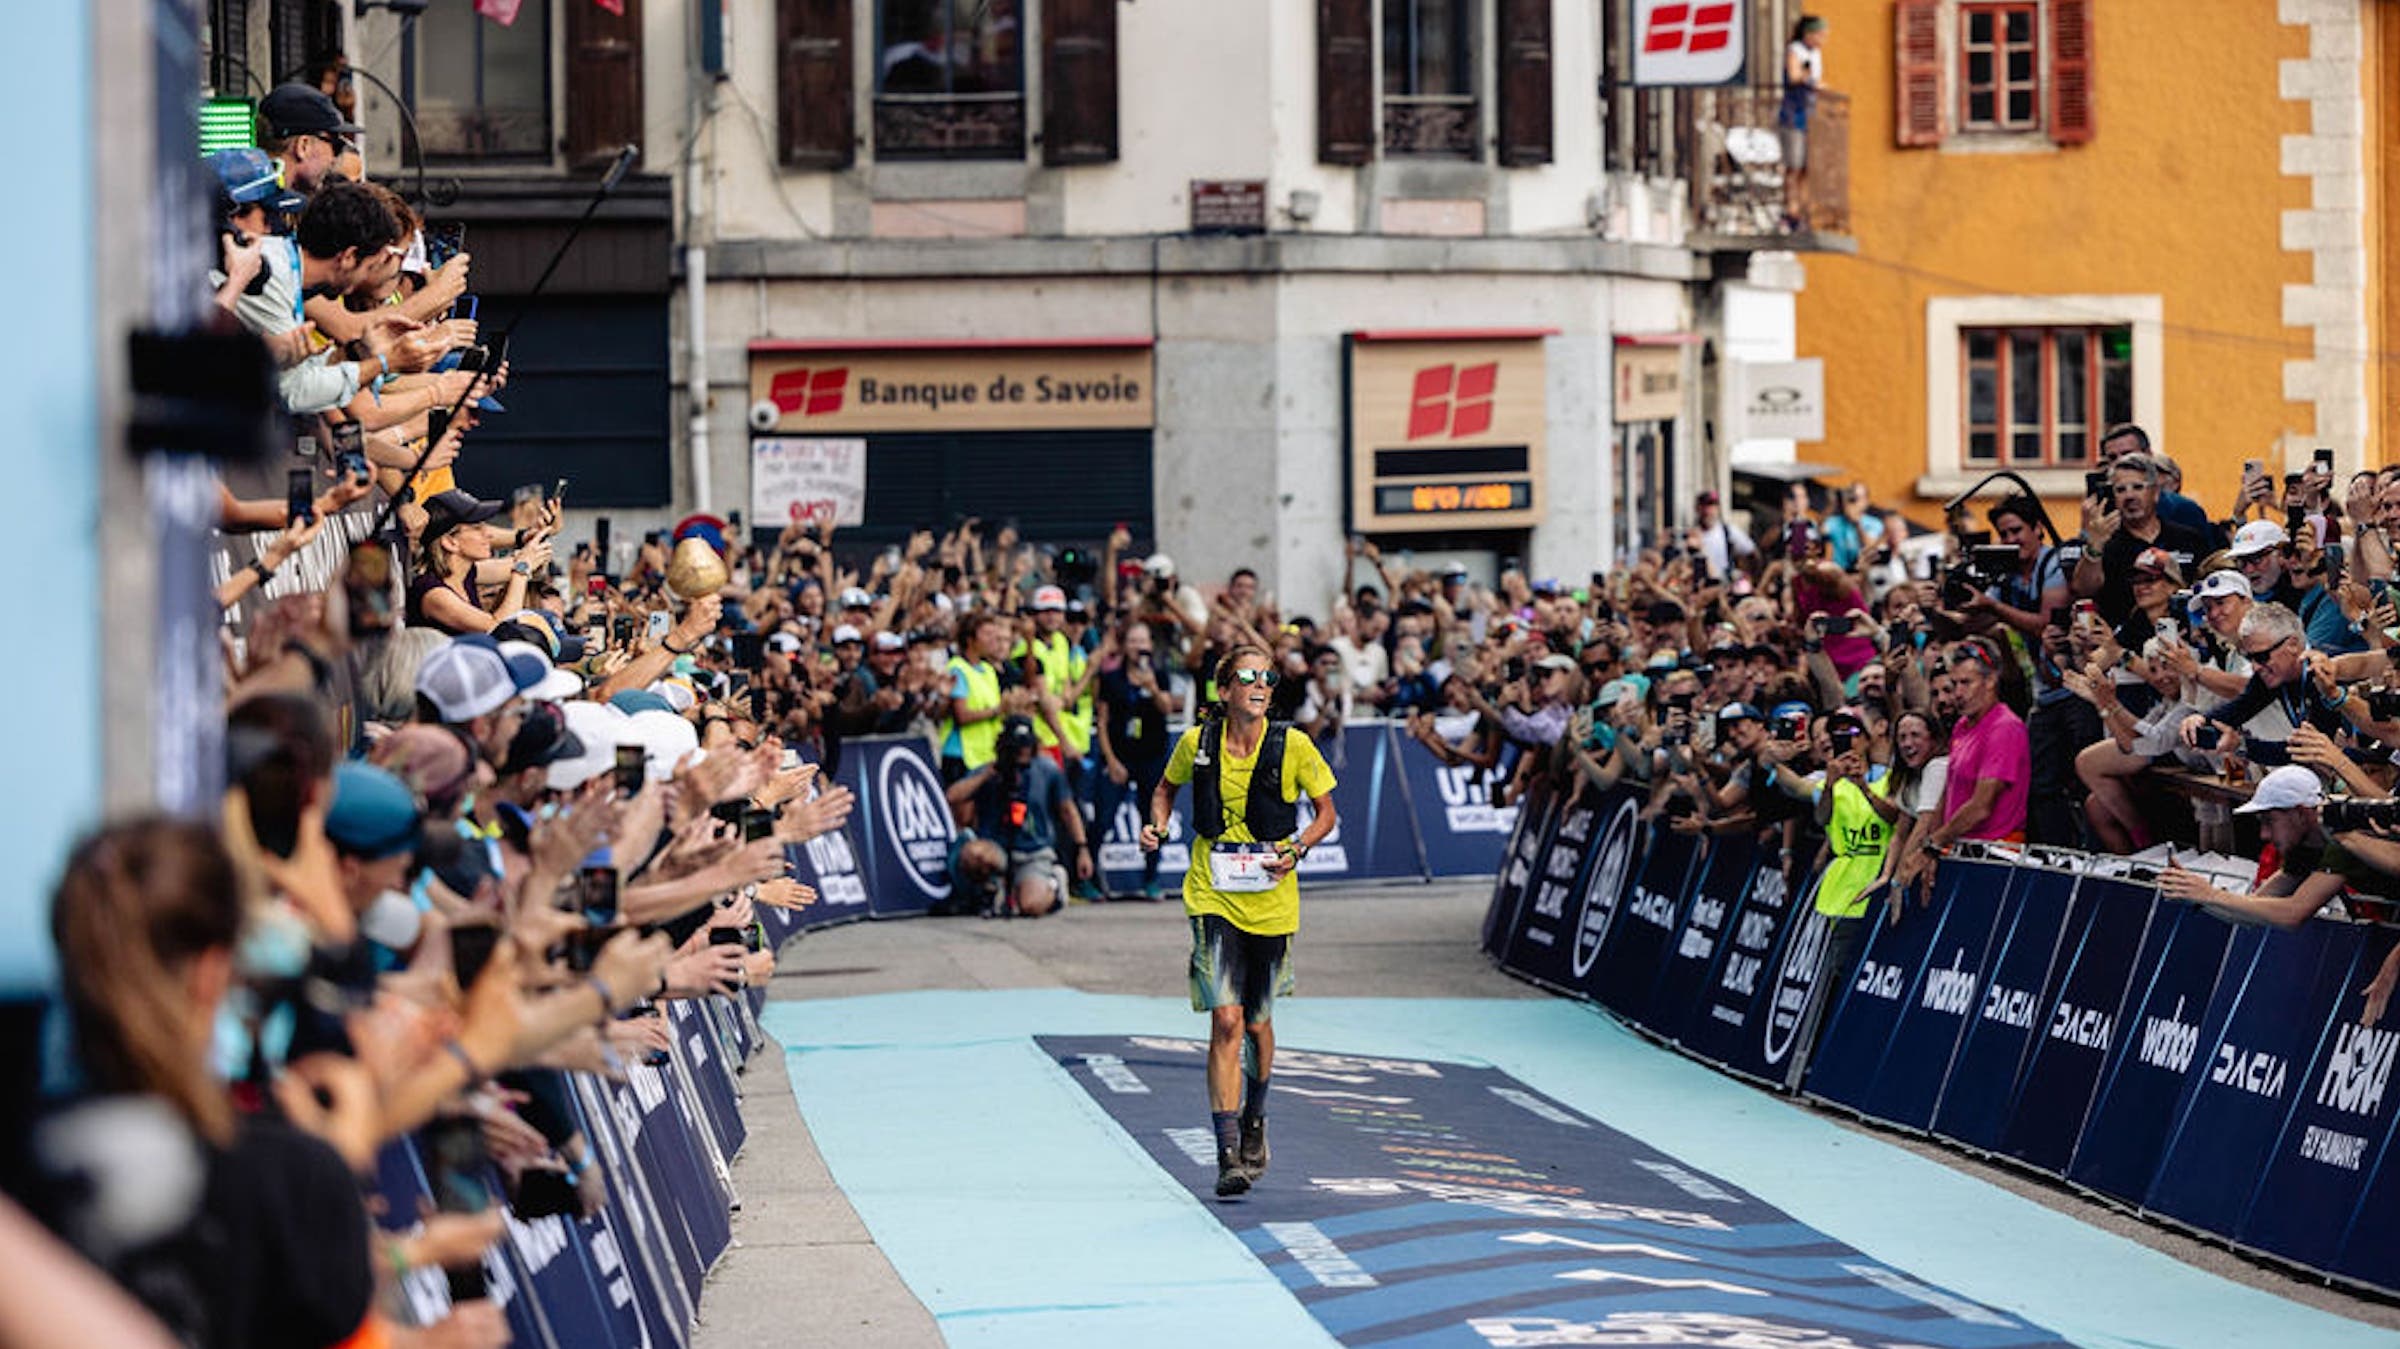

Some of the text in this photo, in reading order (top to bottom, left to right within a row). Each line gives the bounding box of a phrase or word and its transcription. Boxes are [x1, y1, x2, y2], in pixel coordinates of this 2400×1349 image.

[859, 373, 1140, 410] Banque de Savoie
[1983, 984, 2037, 1029] DACIA
[2051, 1002, 2114, 1051] DACIA
[2139, 994, 2200, 1074] wahoo
[2211, 1043, 2289, 1099] DACIA
[2316, 1021, 2400, 1116] HOKA
